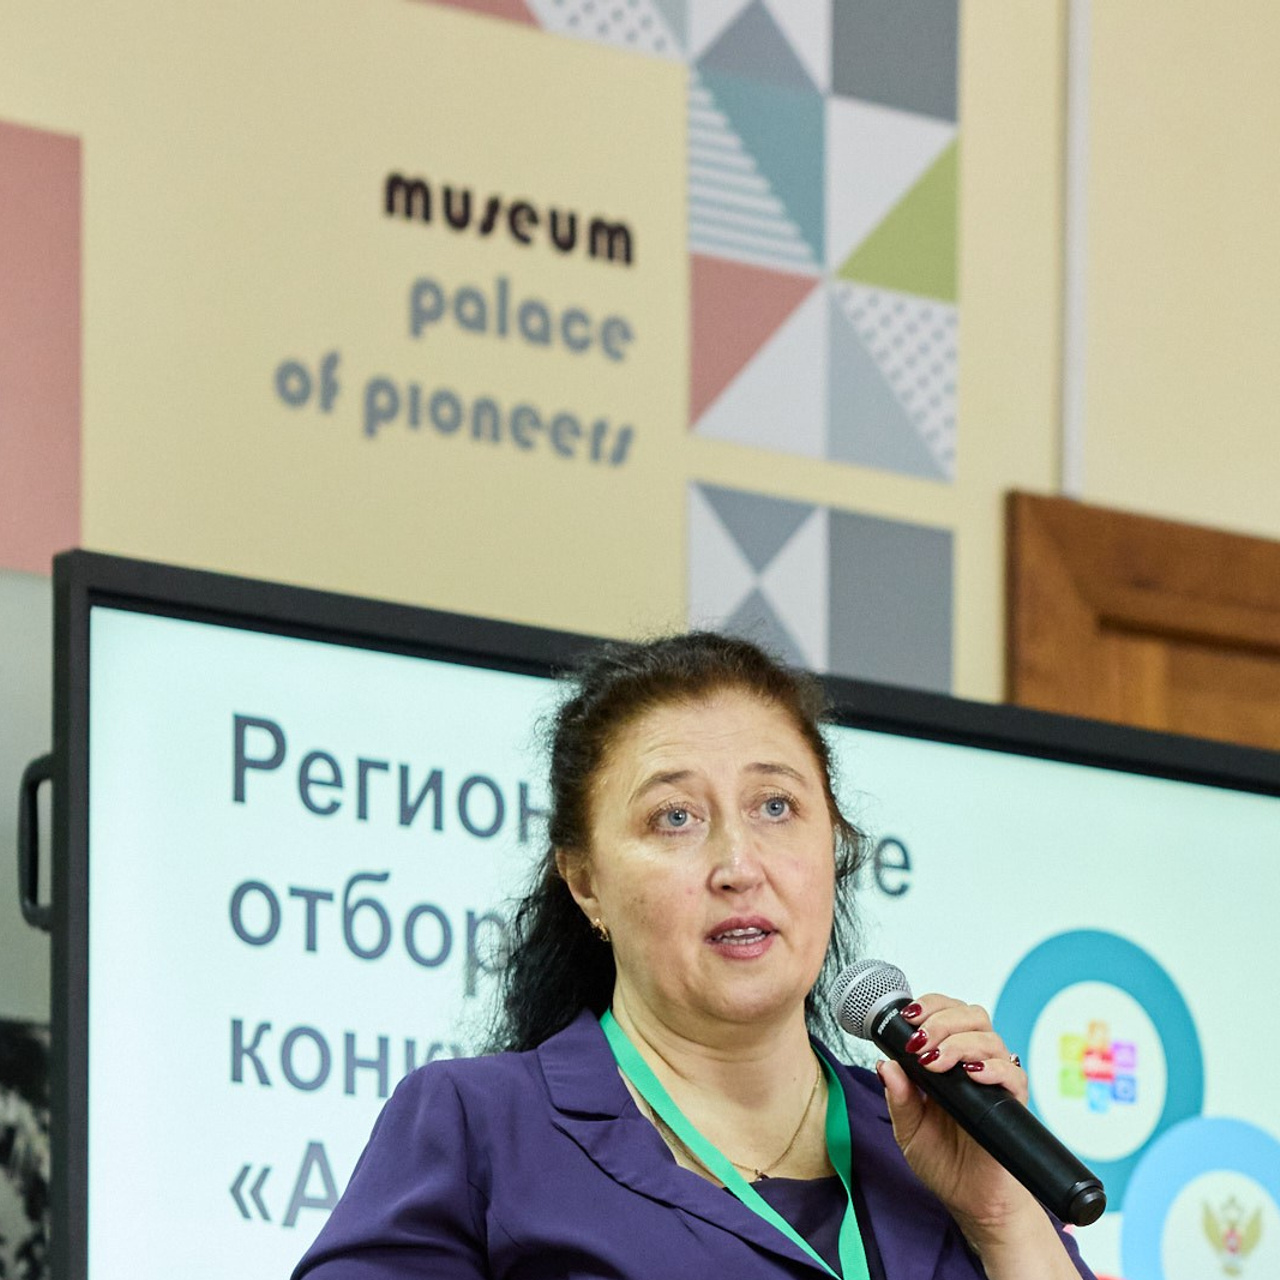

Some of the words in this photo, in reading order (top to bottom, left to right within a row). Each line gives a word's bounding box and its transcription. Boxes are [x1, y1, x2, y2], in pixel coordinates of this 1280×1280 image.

[384, 171, 635, 267] museum
[408, 272, 636, 363] palace
[274, 349, 341, 415] of
[363, 374, 636, 467] pioneers
[229, 871, 512, 997] отбор
[230, 1140, 341, 1228] «А
